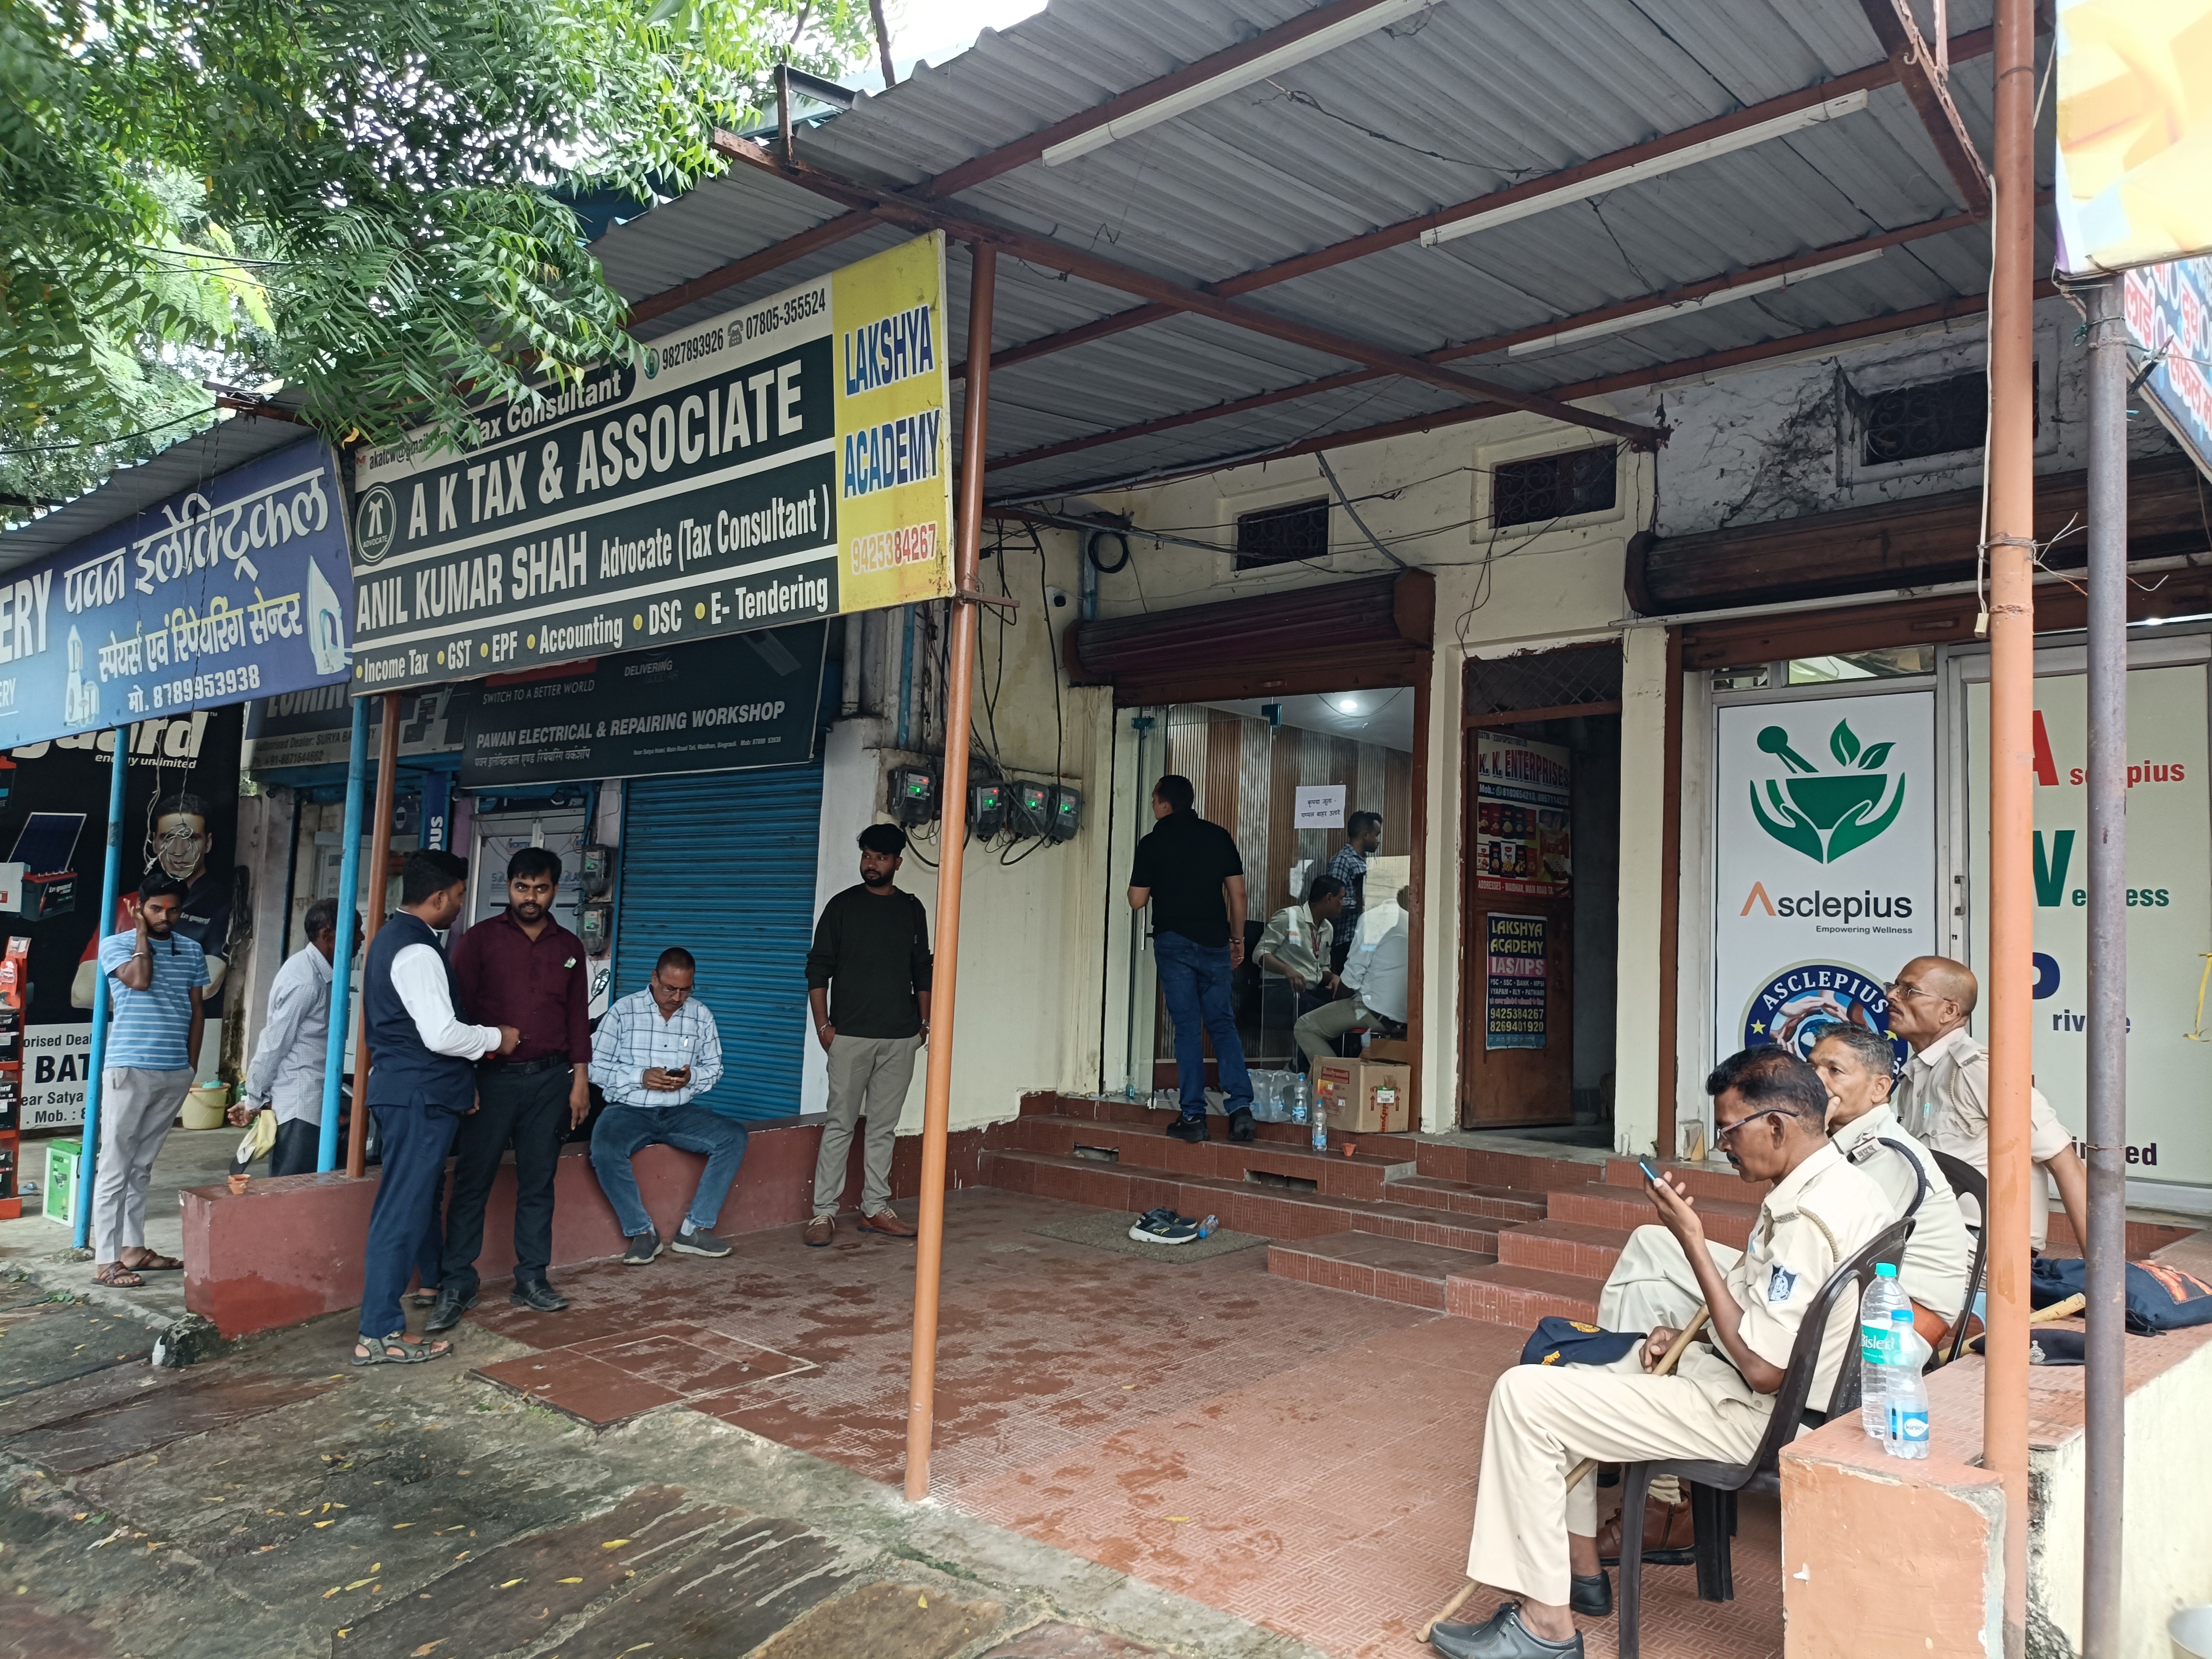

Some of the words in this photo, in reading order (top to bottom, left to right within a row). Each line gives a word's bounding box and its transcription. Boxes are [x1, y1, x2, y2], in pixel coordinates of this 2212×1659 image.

[745, 288, 826, 340] 07805-355524
[662, 328, 724, 370] 9827893926
[843, 305, 934, 397] LAKSHYA
[507, 369, 621, 432] Consultant
[408, 482, 428, 540] A
[438, 472, 458, 532] K
[467, 450, 528, 524] TAX
[539, 441, 564, 505] &
[576, 359, 803, 494] ASSOCIATE
[844, 409, 940, 499] ACADEMY
[356, 575, 408, 633] ANIL
[415, 553, 503, 620] KUMAR
[512, 531, 587, 600] SHAH
[600, 527, 672, 579] Advocate
[717, 488, 817, 554] Consultant
[363, 534, 389, 549] ADVOCATE
[851, 523, 937, 575] 9425384267
[65, 547, 126, 614] पवन
[145, 614, 169, 672] एवं
[247, 586, 303, 645] सेन्टर
[364, 655, 405, 684] Income
[409, 648, 429, 678] Tax
[448, 639, 472, 670] GST
[492, 630, 518, 663] EPF
[539, 614, 623, 654] Accounting
[649, 599, 682, 636] DSC
[735, 575, 829, 621] Tendering
[154, 664, 261, 708] 8789953938
[624, 660, 673, 676] DELIVERING
[483, 690, 511, 705] SWITCH
[513, 689, 524, 701] TO
[526, 688, 532, 699] A
[534, 684, 562, 698] BETTER
[564, 680, 595, 695] WORLD
[476, 730, 516, 749] PAWAN
[518, 721, 593, 746] ELECTRICAL
[596, 721, 607, 738] &
[610, 711, 687, 736] REPAIRING
[692, 700, 785, 728] WORKSHOP
[1505, 749, 1570, 789] ENTERPRISES
[1307, 799, 1320, 807] कृपया
[1740, 881, 1913, 924] Asclepius
[1490, 939, 1543, 956] ACADEMY
[1492, 920, 1542, 937] LAKSHYA
[1816, 925, 1870, 935] Empowering
[1872, 926, 1913, 934] Wellness
[1492, 957, 1544, 975] IAS/IPS
[1490, 1008, 1544, 1019] 9425384267
[1763, 971, 1889, 1014] ASCLEPIUS
[1490, 1021, 1544, 1032] 8269401920
[47, 1092, 84, 1106] Satya
